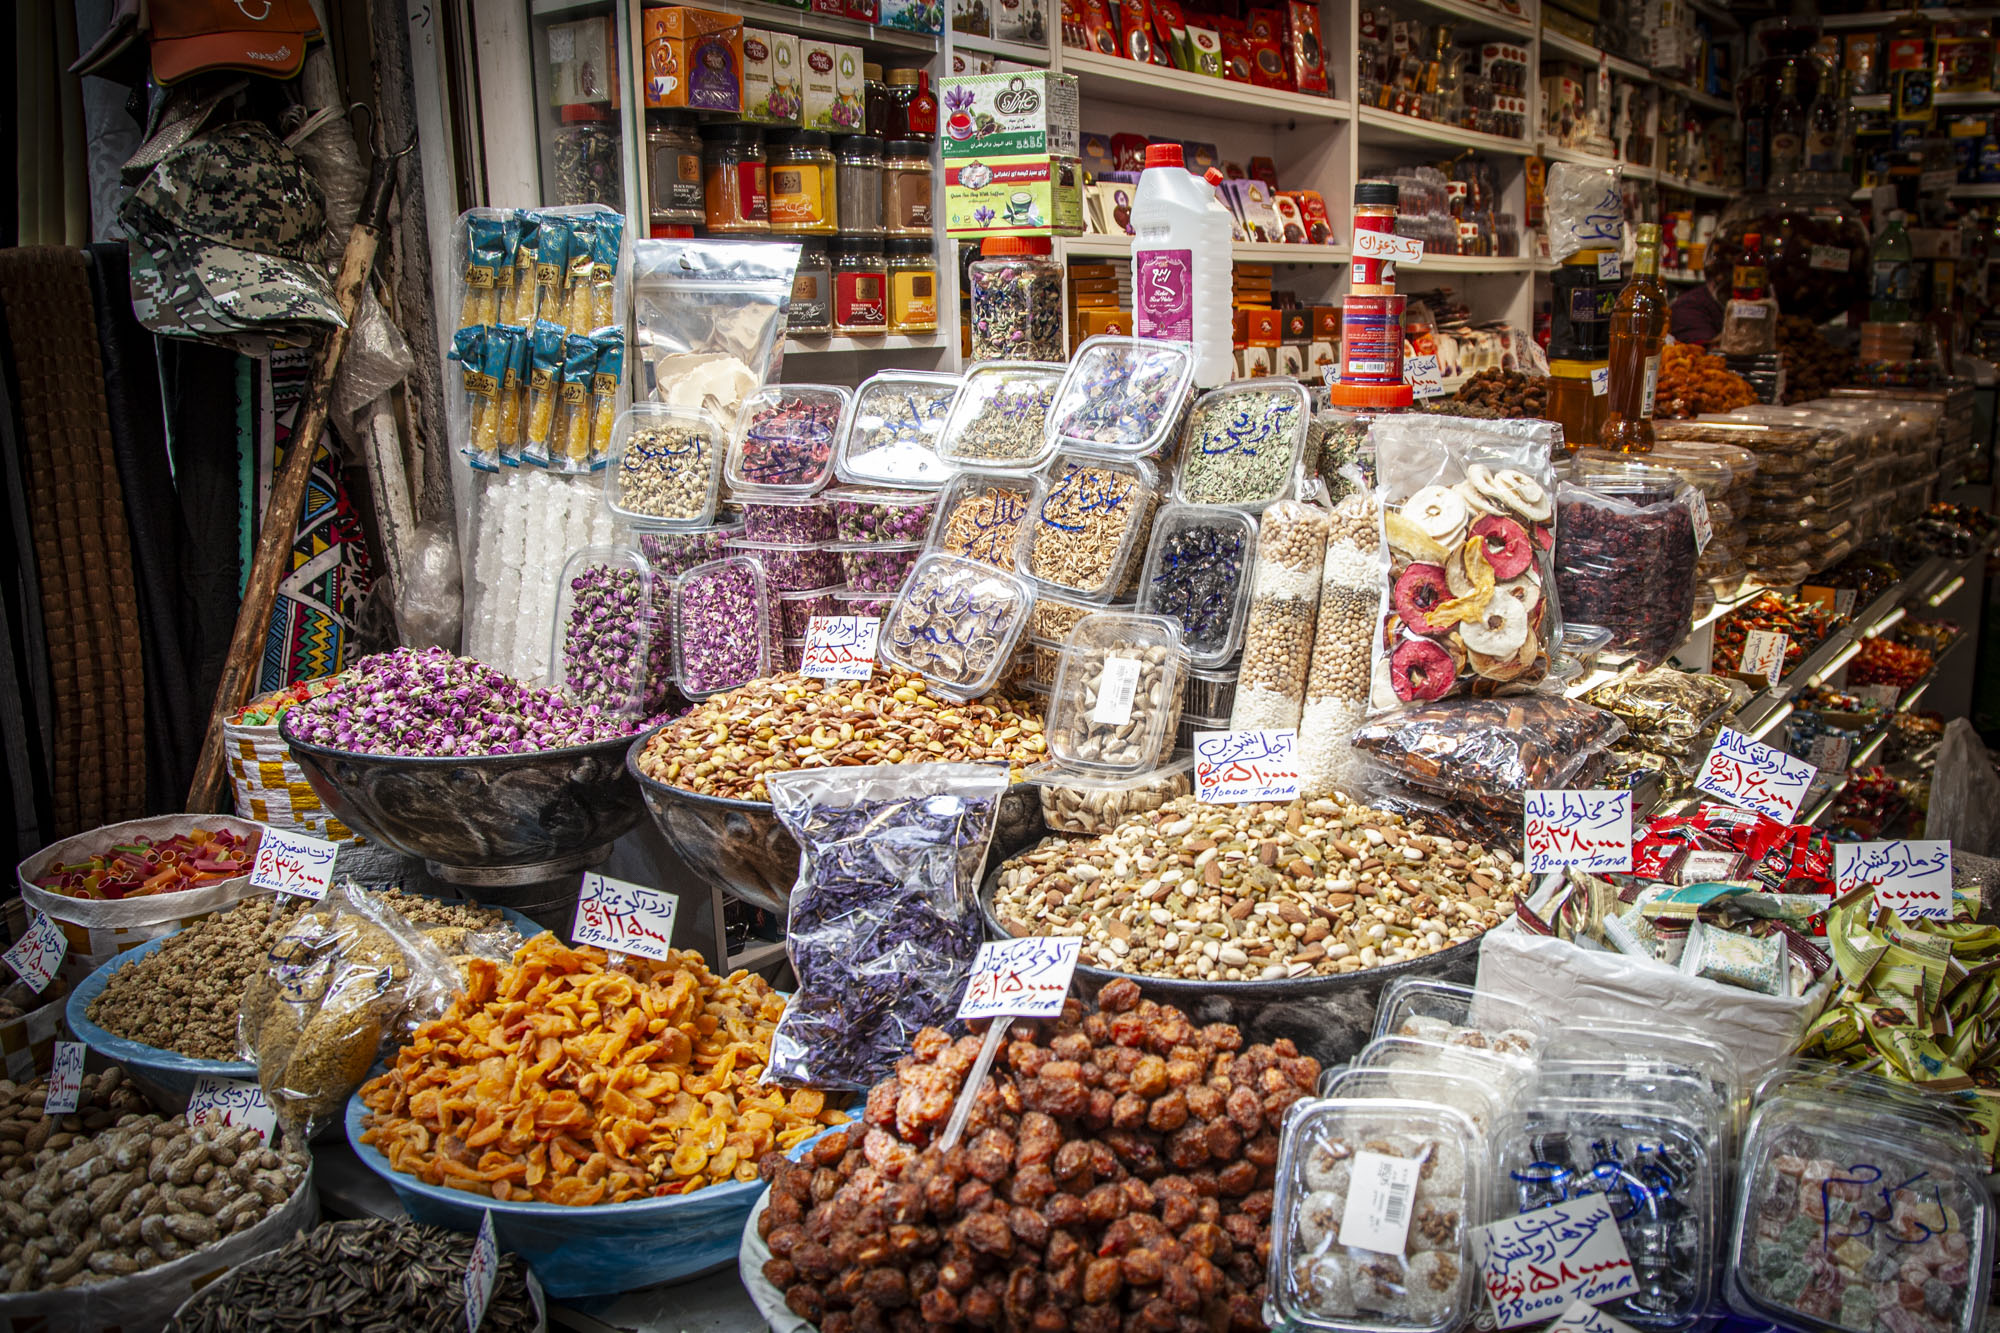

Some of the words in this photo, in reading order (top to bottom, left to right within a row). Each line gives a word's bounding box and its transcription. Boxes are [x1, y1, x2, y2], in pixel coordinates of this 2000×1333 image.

[1359, 235, 1396, 257] زعفران
[1395, 240, 1422, 261] رنگ
[1202, 405, 1294, 455] آویشن
[826, 617, 854, 639] بوداده
[1526, 792, 1556, 818] فله
[1551, 792, 1606, 828] مخلوط
[308, 847, 335, 865] توت
[1902, 845, 1949, 878] خرما
[579, 876, 622, 905] ممتاز
[578, 925, 620, 943] 215000
[212, 1080, 252, 1108] زمینی
[1497, 1295, 1564, 1326] 580000
